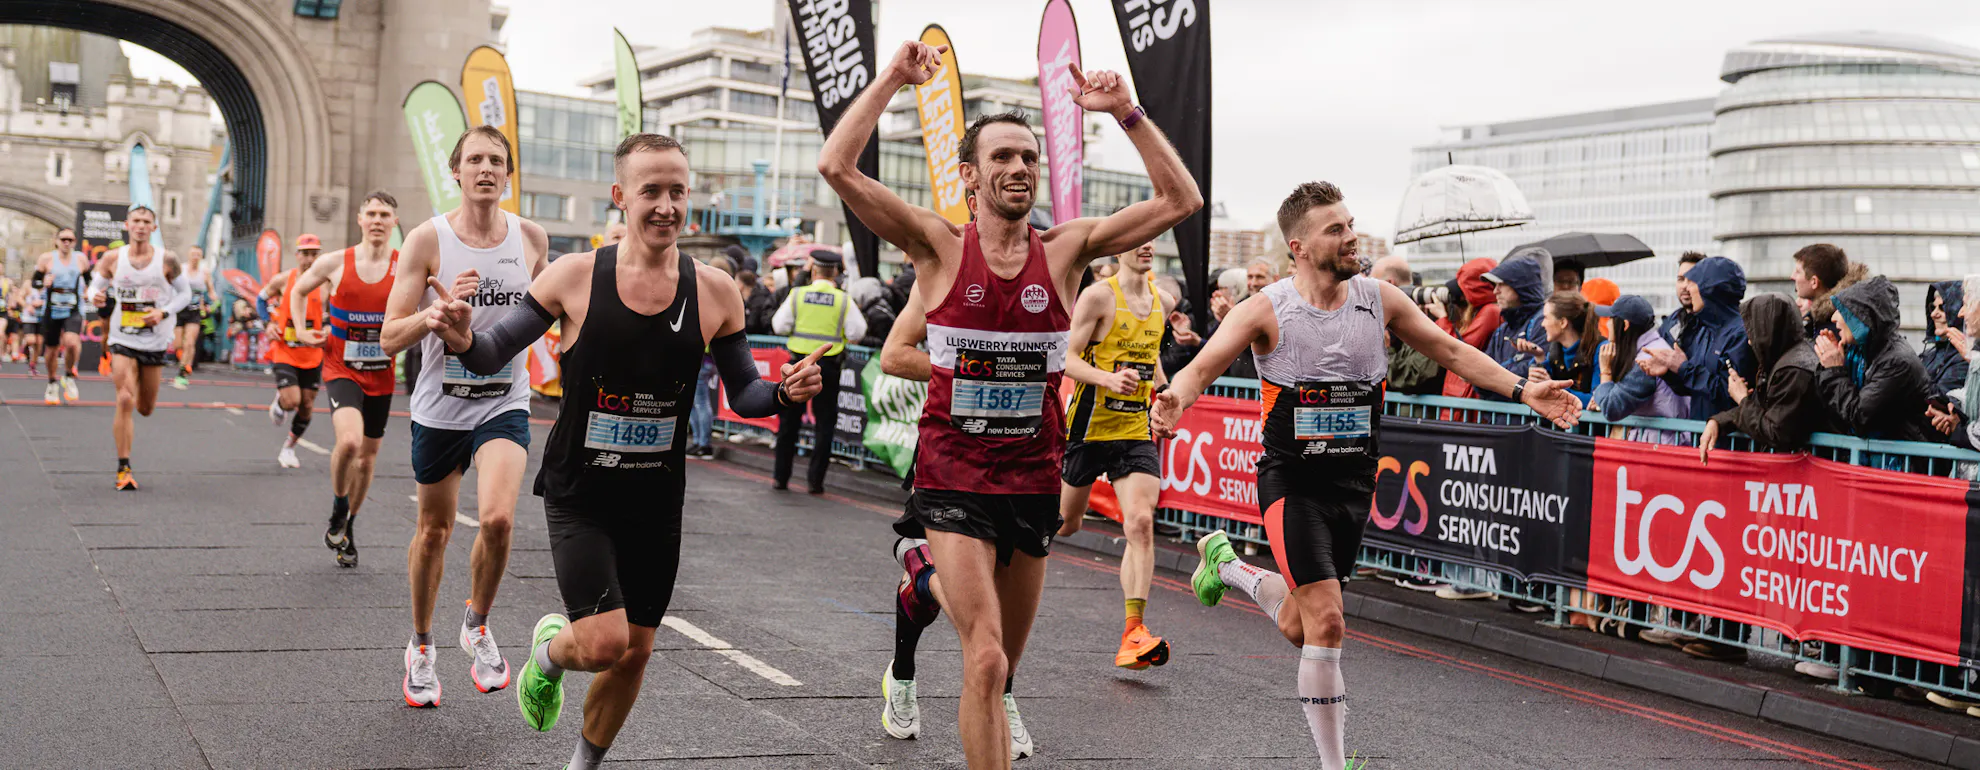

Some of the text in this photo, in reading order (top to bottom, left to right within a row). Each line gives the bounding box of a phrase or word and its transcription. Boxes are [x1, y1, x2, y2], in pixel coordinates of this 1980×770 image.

[931, 64, 966, 206] VERSUS
[479, 276, 504, 291] alley
[466, 289, 523, 308] riders
[804, 292, 834, 306] POLICE
[946, 336, 1008, 351] LLISWERRY
[1010, 341, 1058, 351] RUNNERS
[960, 353, 992, 377] tcs
[597, 388, 630, 411] tcs
[975, 387, 1026, 410] 1587
[1300, 386, 1328, 405] tcs
[610, 423, 659, 445] 1499
[1004, 426, 1035, 434] balance
[1314, 413, 1356, 432] 1155
[1443, 443, 1497, 475] TATA
[1219, 478, 1259, 505] SERVI
[1440, 479, 1569, 524] CONSULTANCY
[1745, 481, 1818, 520] TATA
[1438, 514, 1520, 555] SERVICES
[1614, 466, 1726, 590] tcs
[1742, 524, 1928, 583] CONSULTANCY
[1740, 567, 1849, 617] SERVICES
